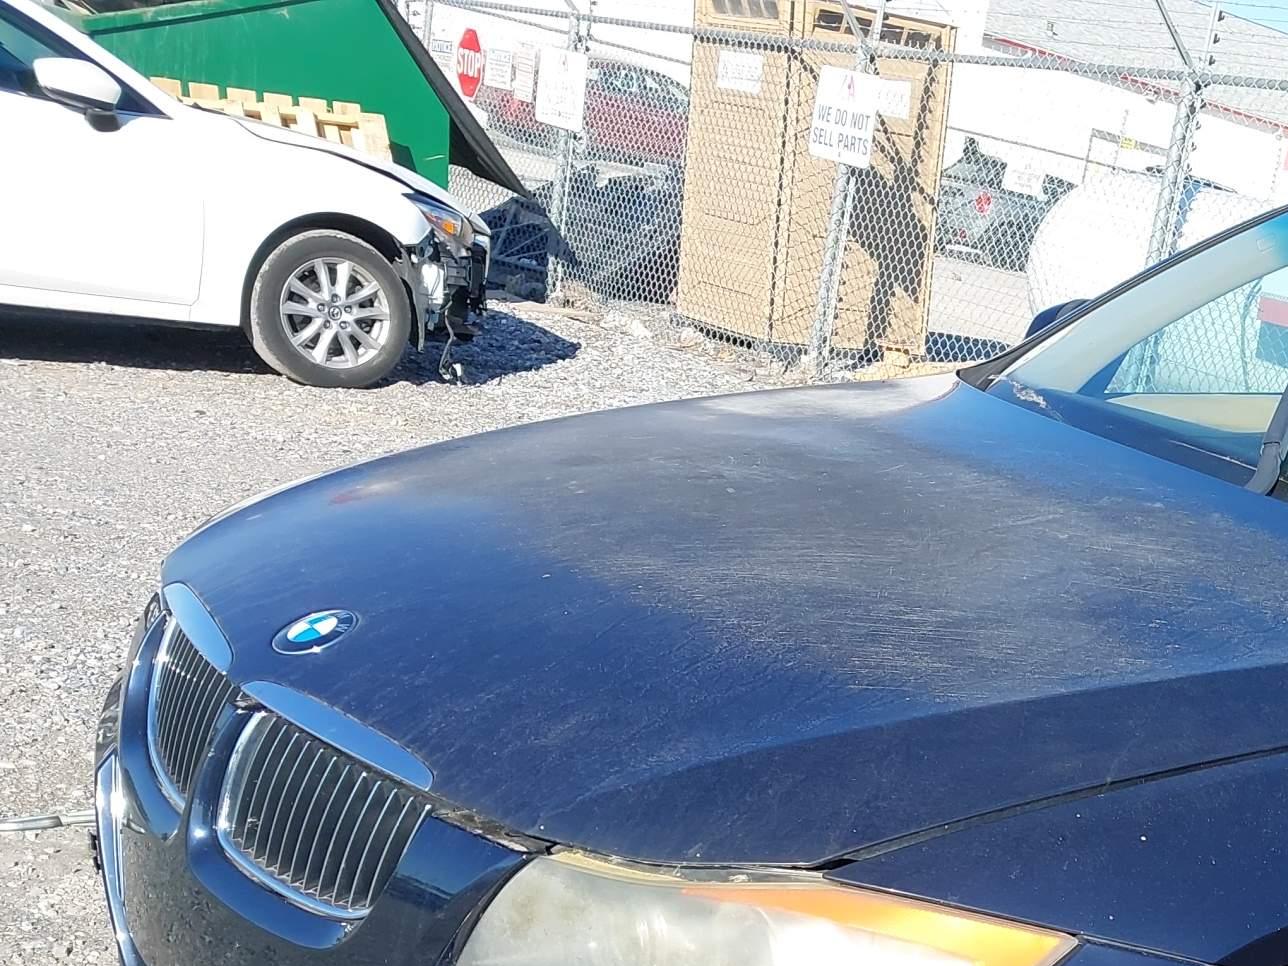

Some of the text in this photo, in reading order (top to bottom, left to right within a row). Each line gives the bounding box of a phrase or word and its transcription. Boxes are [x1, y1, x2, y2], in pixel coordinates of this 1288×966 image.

[456, 48, 481, 78] STOP
[817, 103, 872, 132] WE DO NOT
[812, 126, 869, 156] SELL PARTS
